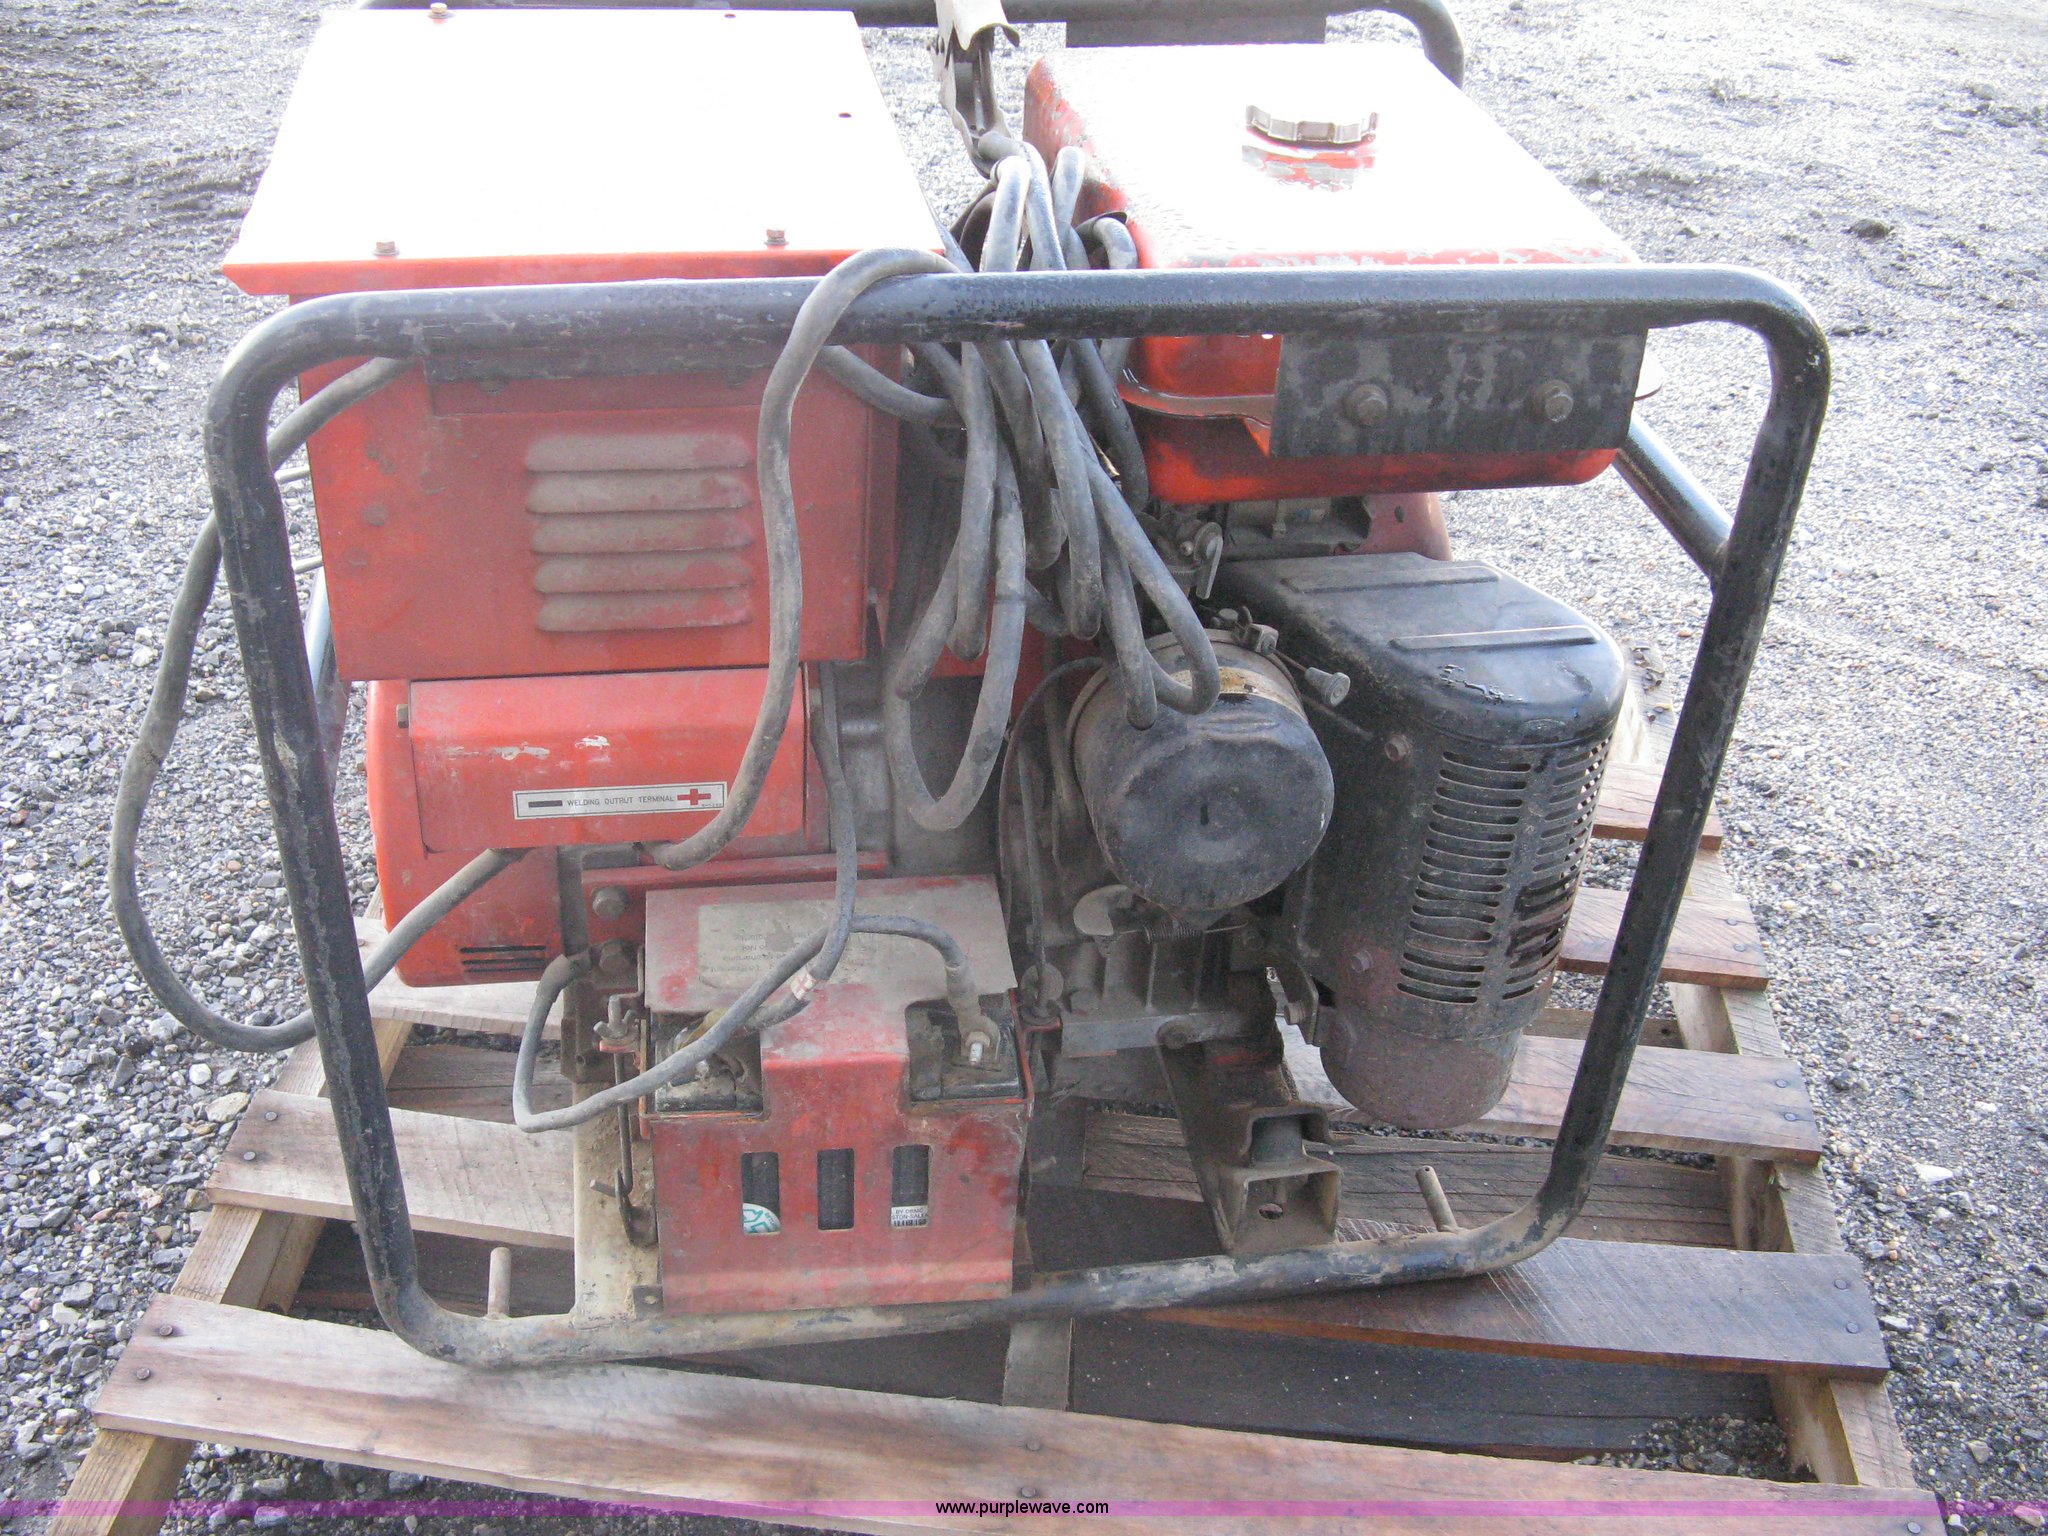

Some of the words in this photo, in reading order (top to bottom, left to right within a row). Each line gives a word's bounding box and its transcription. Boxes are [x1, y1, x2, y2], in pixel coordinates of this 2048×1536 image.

[566, 798, 600, 807] WELDING
[604, 796, 634, 805] OUTPUT
[638, 794, 674, 803] TERMINAL
